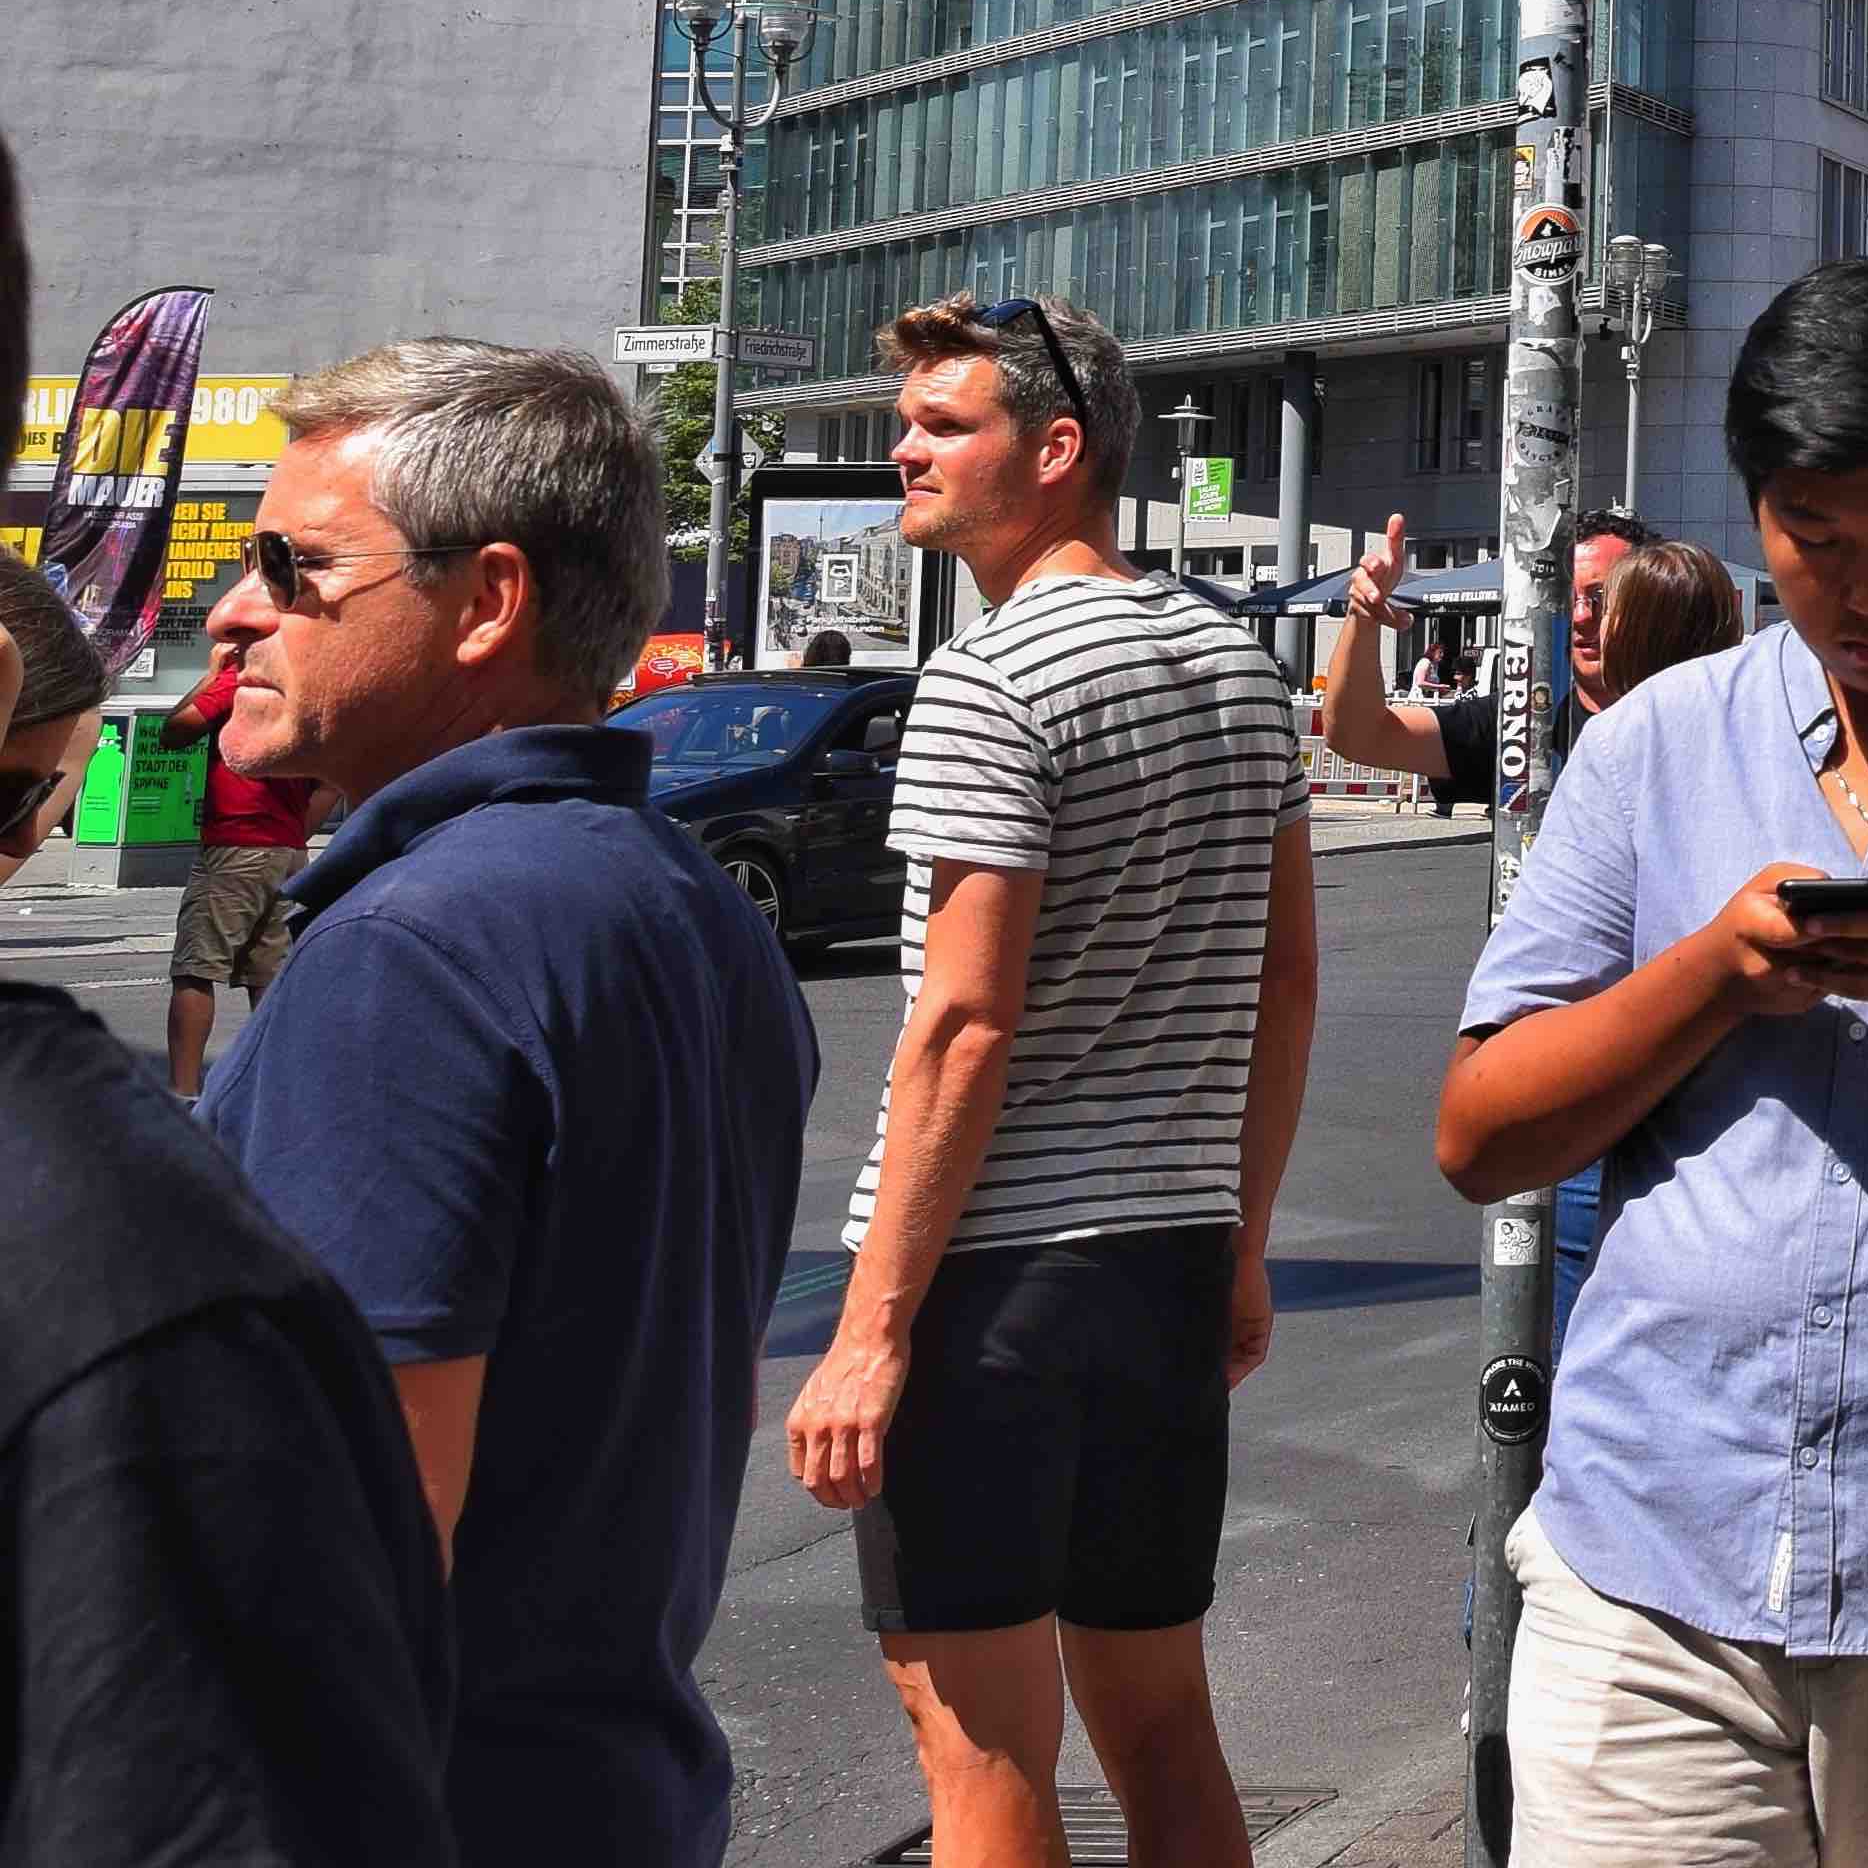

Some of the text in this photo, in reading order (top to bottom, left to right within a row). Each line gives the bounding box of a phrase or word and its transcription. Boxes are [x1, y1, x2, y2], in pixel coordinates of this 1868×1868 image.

[624, 334, 706, 353] Zimmerstraße
[744, 338, 808, 362] Friedrichstraße
[73, 407, 177, 477] DIE
[66, 476, 167, 508] MAUER
